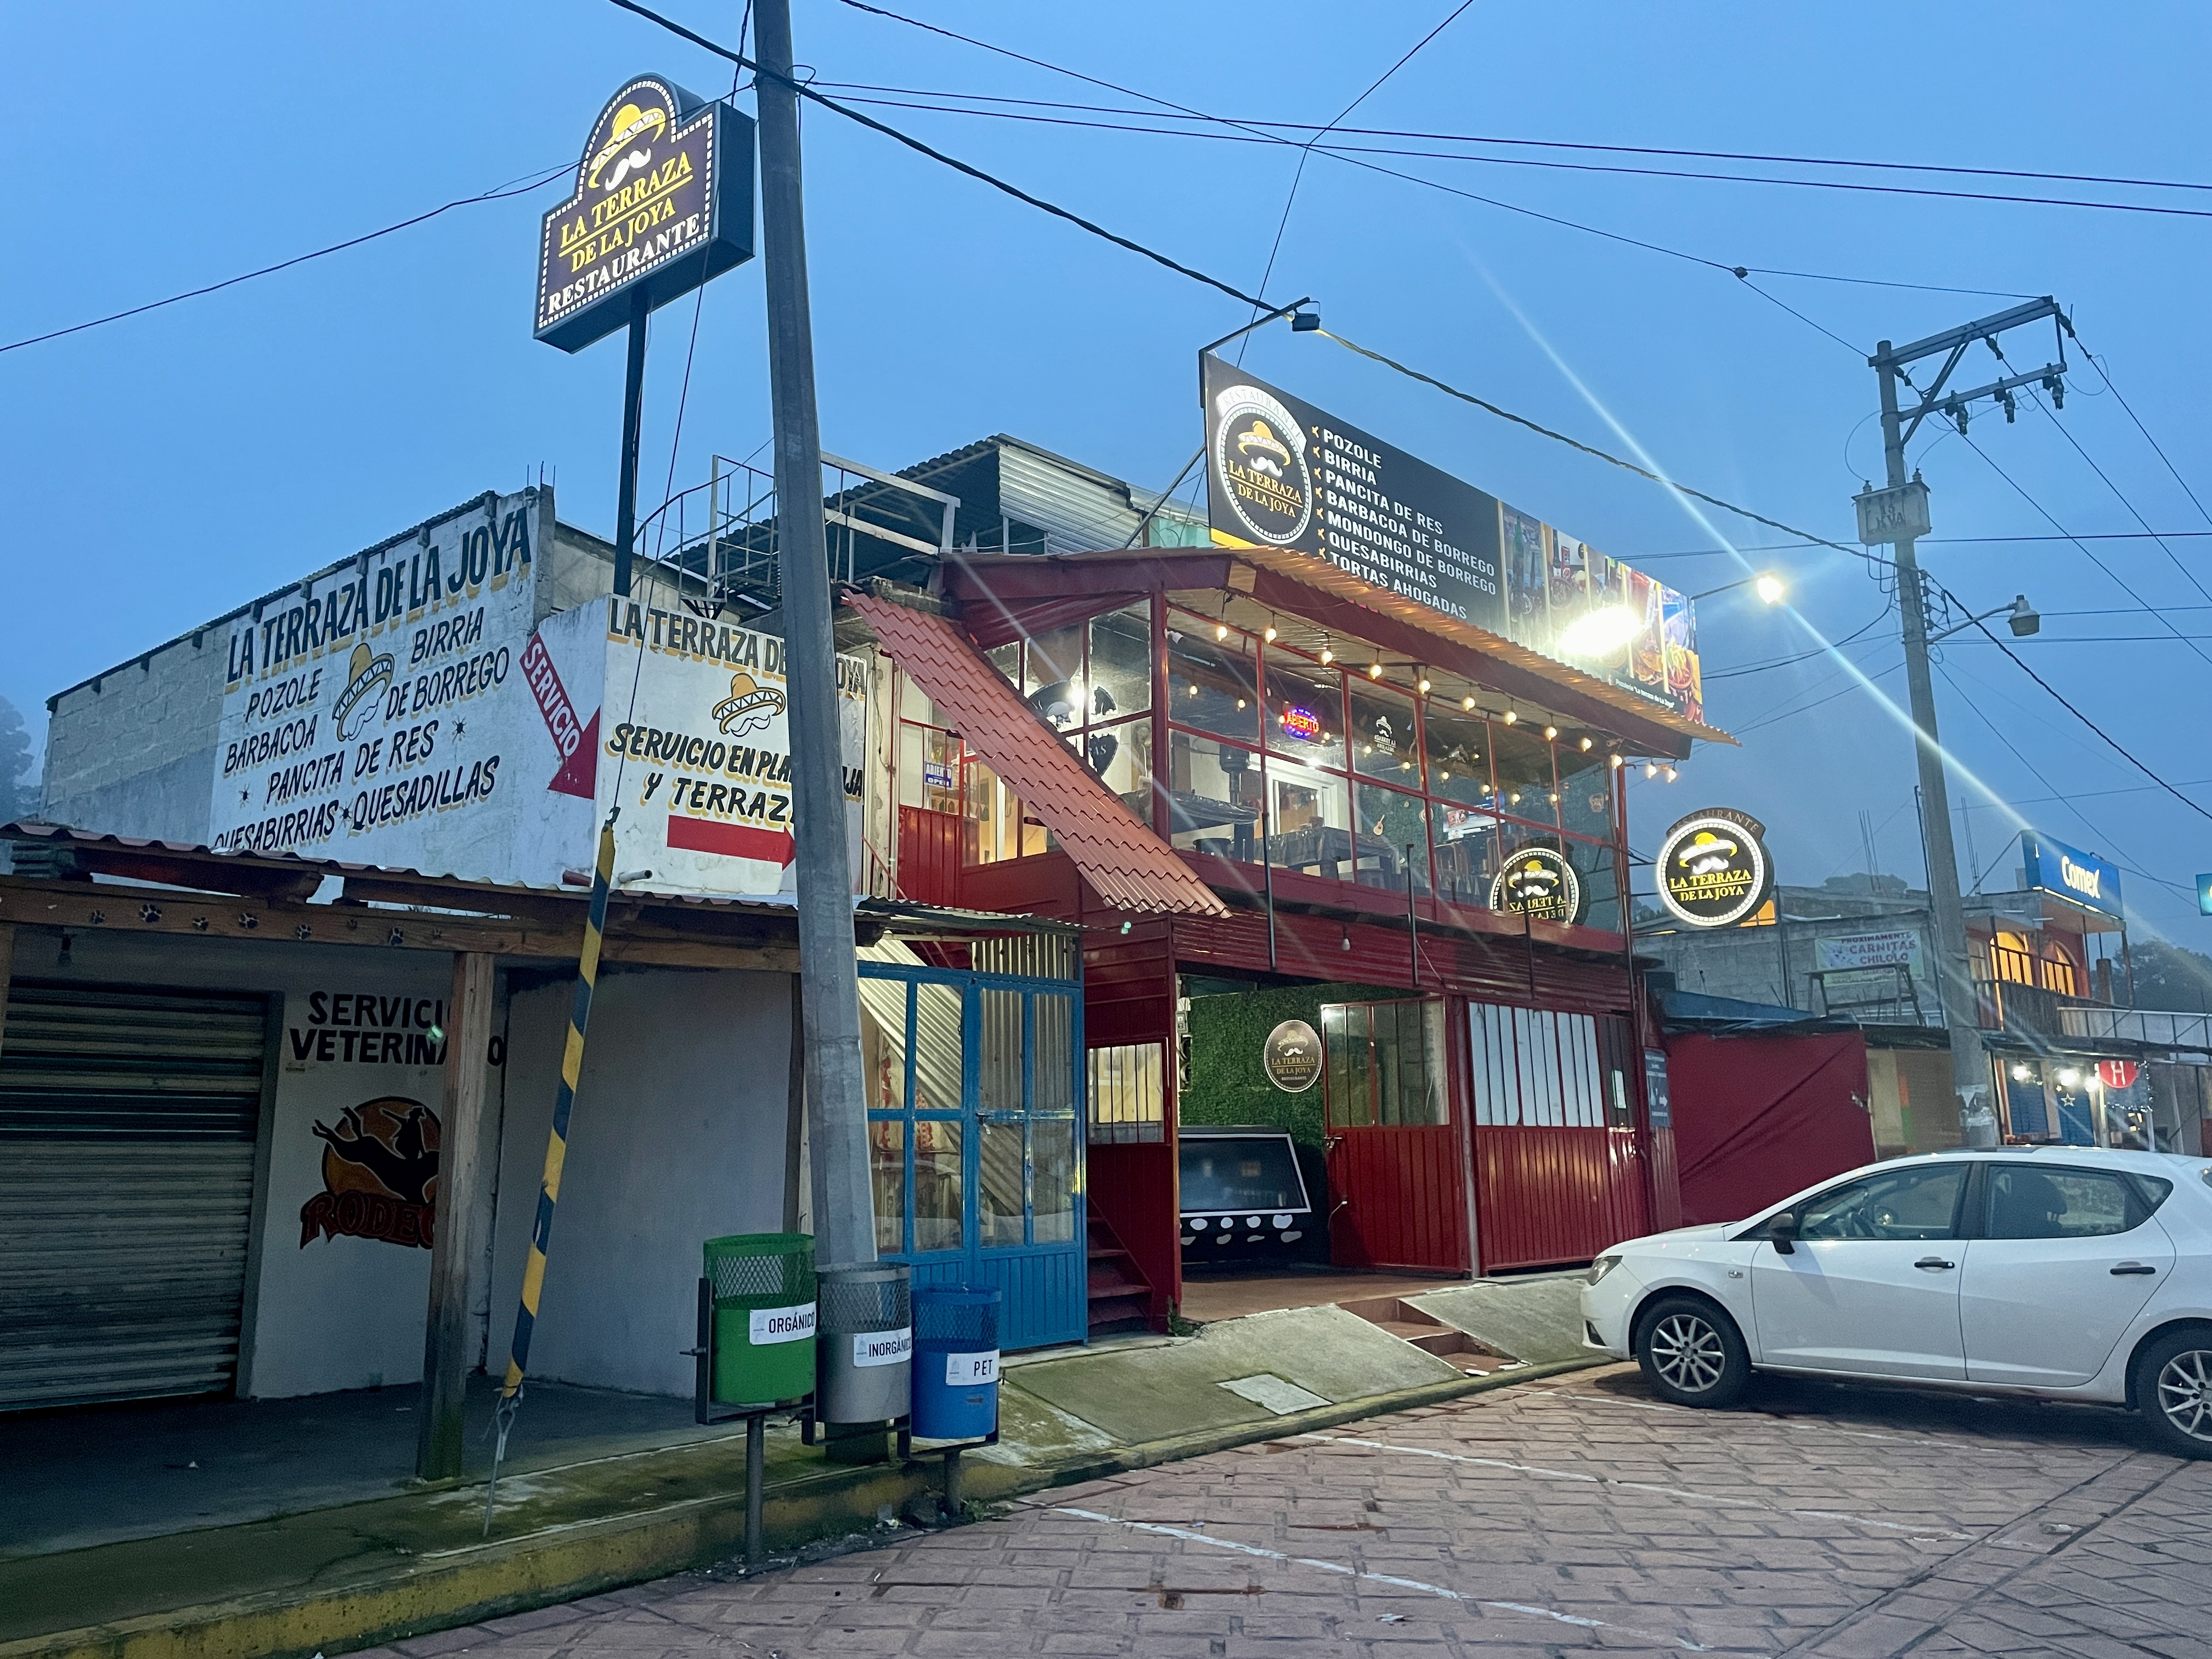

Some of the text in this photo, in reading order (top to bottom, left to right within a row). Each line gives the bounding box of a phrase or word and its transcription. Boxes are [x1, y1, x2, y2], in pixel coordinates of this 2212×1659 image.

[561, 151, 693, 249] LA TERRAZA
[571, 196, 676, 273] DE LA JOYA
[547, 212, 701, 315] RESTAURANTE
[1222, 388, 1303, 442] RESTAURANTE
[1323, 428, 1383, 469] POZOLE
[1324, 448, 1378, 486] BIRRIA
[1228, 459, 1303, 504] LA TERRAZA
[1237, 483, 1296, 518] DE LA JOYA
[1325, 469, 1444, 535] PANCITA DE RES
[1327, 489, 1495, 577] BARBACOA DE BORREGO
[1328, 510, 1497, 596] MONDONGO DE BORREGO
[1329, 531, 1438, 589] QUESABIRRIAS
[227, 506, 532, 684] LA TERRAZA DE LA JOYA
[1329, 550, 1468, 619] TORTAS AHOGADAS
[410, 606, 484, 664] BIRRIA
[610, 597, 643, 641] LA
[647, 608, 760, 670] TERRAZA
[245, 668, 324, 723] POZOLE
[386, 646, 510, 721] DE BORREGO
[524, 641, 580, 757] SERVICIO
[224, 714, 319, 775] BARBACOA
[266, 719, 439, 805] PANCITA DE RES
[727, 743, 756, 776] EN
[349, 754, 500, 831] QUESADILLAS
[645, 772, 794, 824] Y TERRAZ
[1669, 869, 1752, 889] LA TERRAZA
[1680, 885, 1745, 902] DE LA JOYA
[2061, 855, 2101, 899] Comex
[1849, 939, 1917, 955] CARNITAS
[307, 991, 450, 1029] SERVICI
[1282, 1056, 1315, 1065] TERRAZA
[1295, 1066, 1311, 1076] JOYA
[768, 1311, 816, 1334] ORGÁNICO
[974, 1359, 993, 1376] PET
